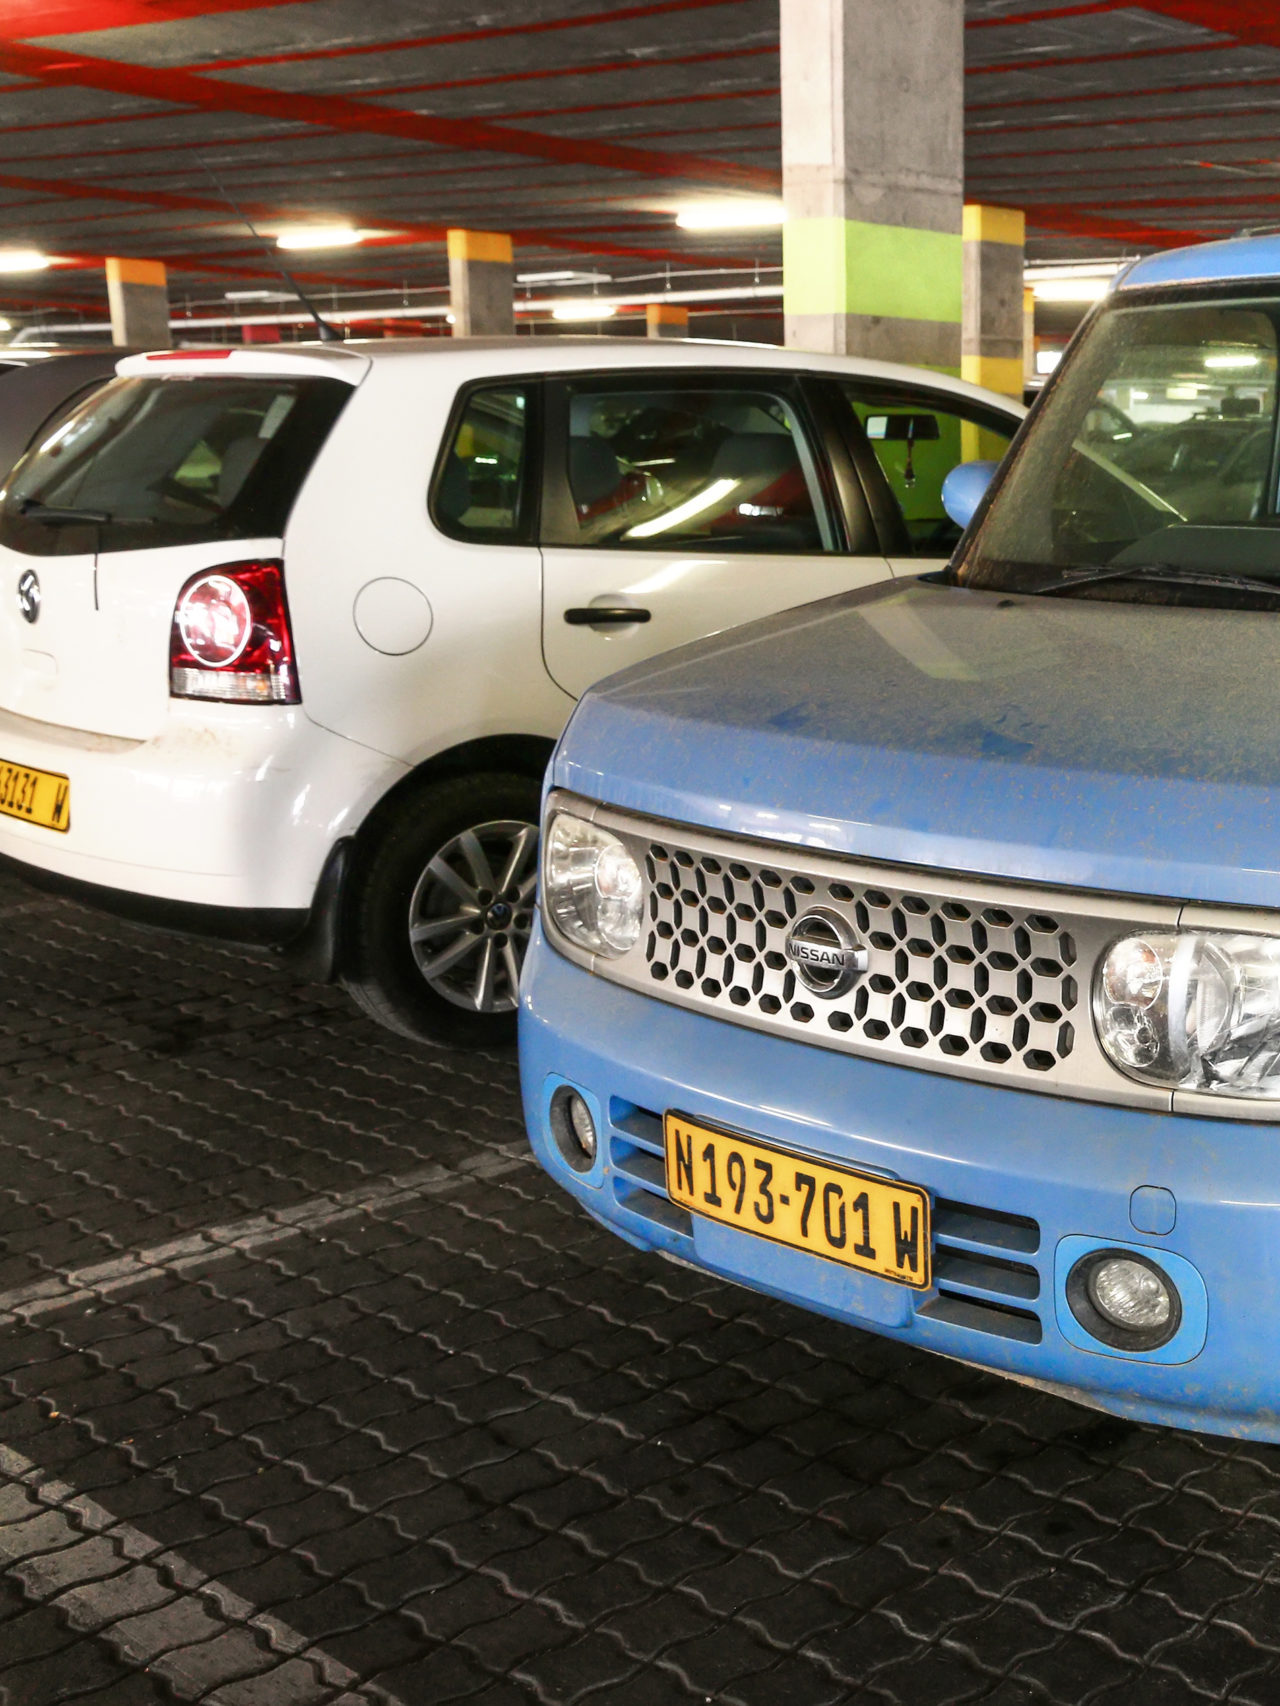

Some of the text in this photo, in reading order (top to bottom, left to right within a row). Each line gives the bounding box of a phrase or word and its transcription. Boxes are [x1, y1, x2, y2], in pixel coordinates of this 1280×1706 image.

[52, 782, 69, 823] W
[788, 942, 845, 966] NISSAN
[675, 1129, 918, 1273] N193-701 W
